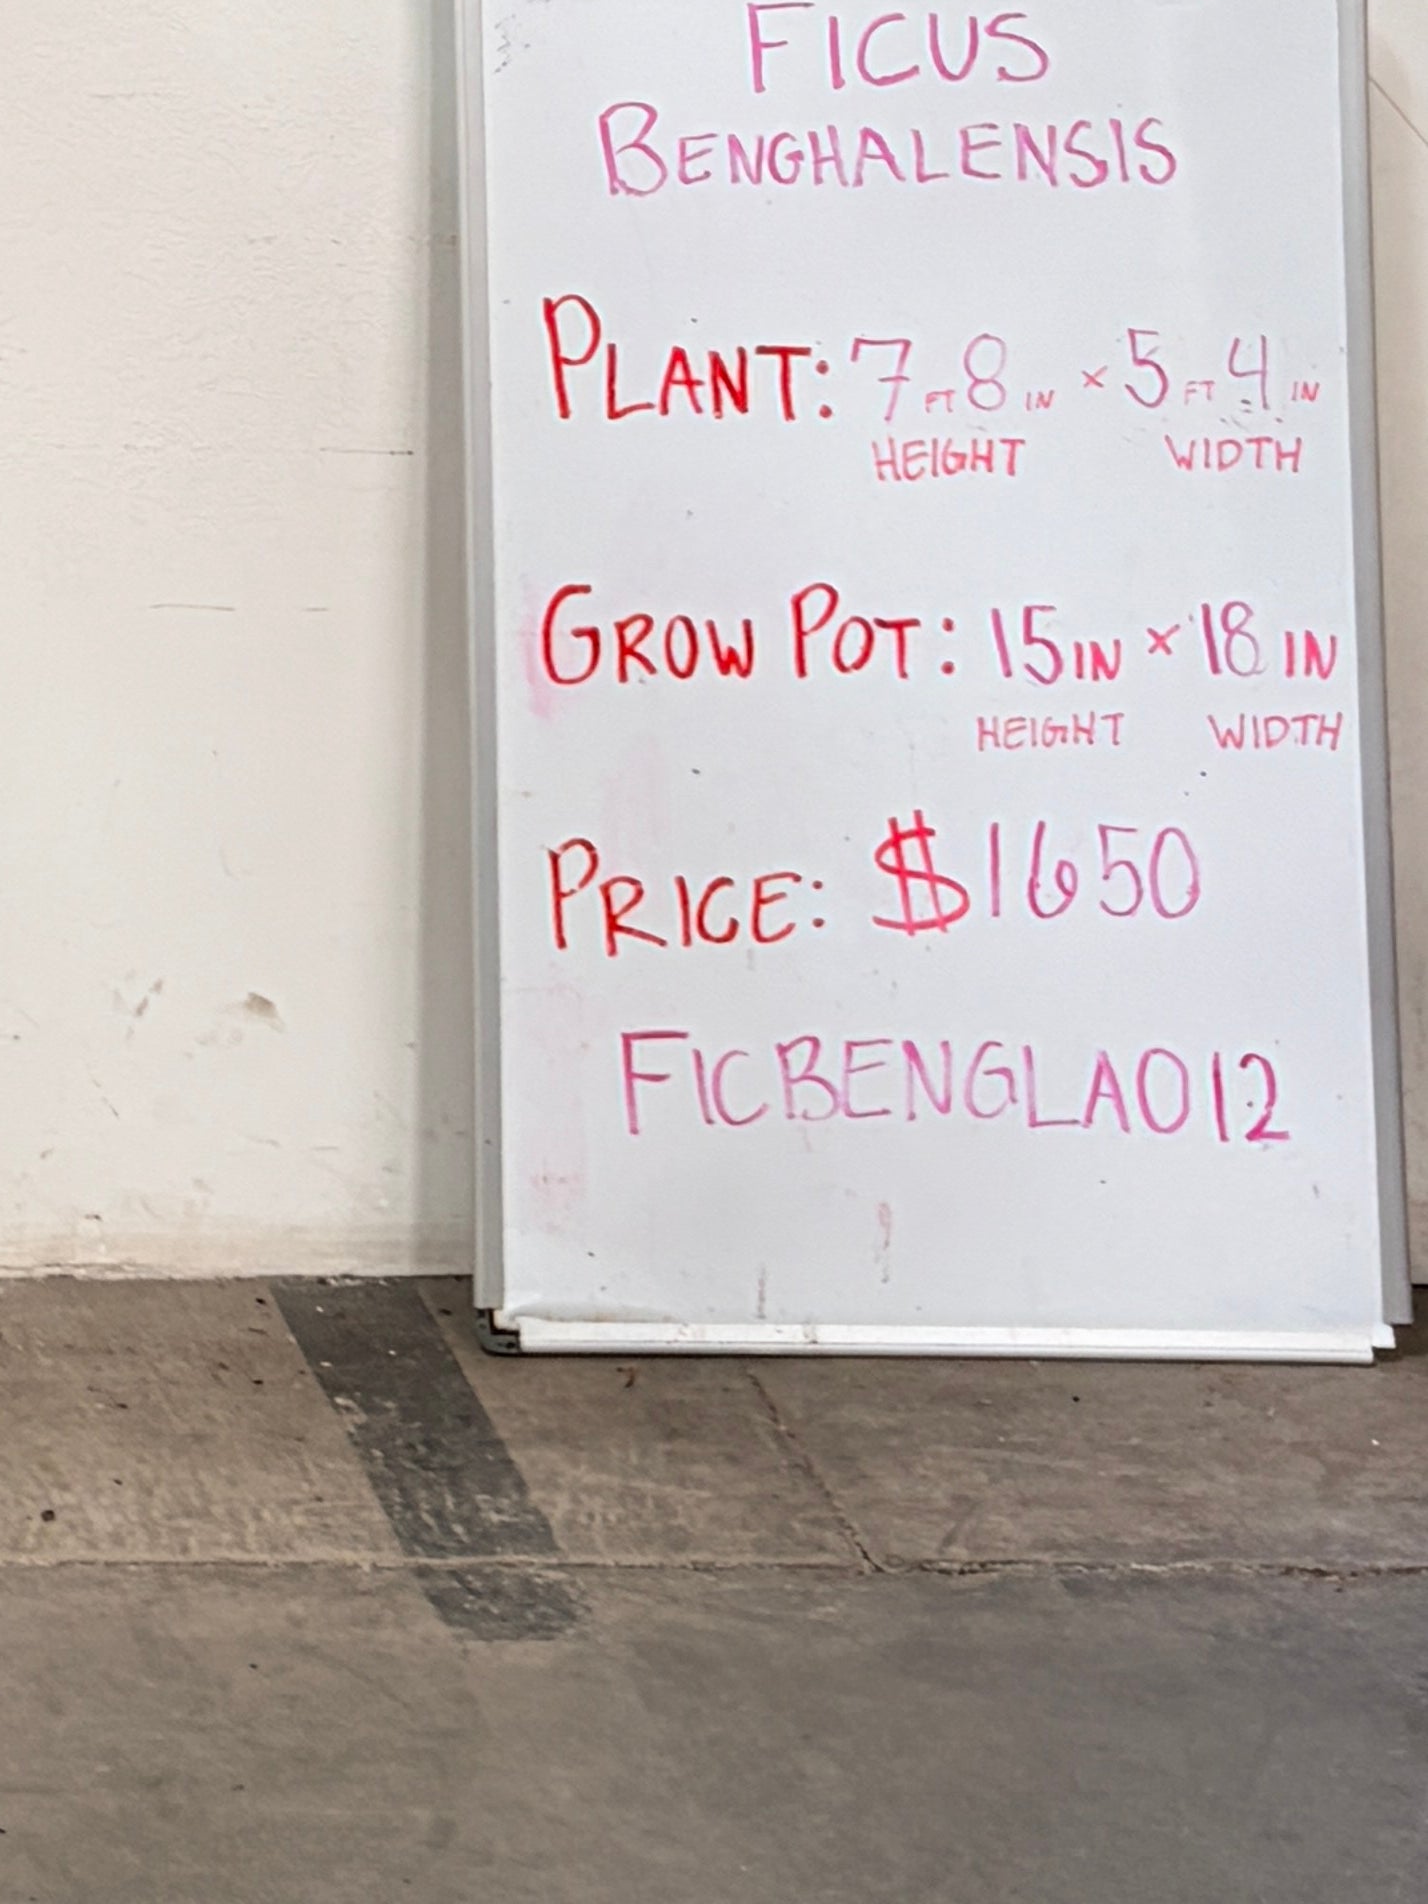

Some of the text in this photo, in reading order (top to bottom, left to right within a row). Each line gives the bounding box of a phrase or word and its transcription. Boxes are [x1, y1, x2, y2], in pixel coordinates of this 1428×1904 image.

[747, 4, 1048, 93] FICUS
[597, 103, 1176, 195] BENGHALENSIS
[541, 294, 833, 423] PLANT:
[849, 337, 912, 422] 7
[962, 332, 1008, 412] 8
[1025, 389, 1055, 412] IN
[1123, 327, 1170, 409] 5
[1227, 333, 1270, 411] 4
[1290, 380, 1320, 402] IN
[873, 436, 1301, 481] HEIGHT WIDTH
[538, 583, 756, 688] GROW
[789, 582, 955, 681] POT:
[976, 710, 1344, 752] HEIGHT WIDTH
[547, 838, 824, 959] PRICE:
